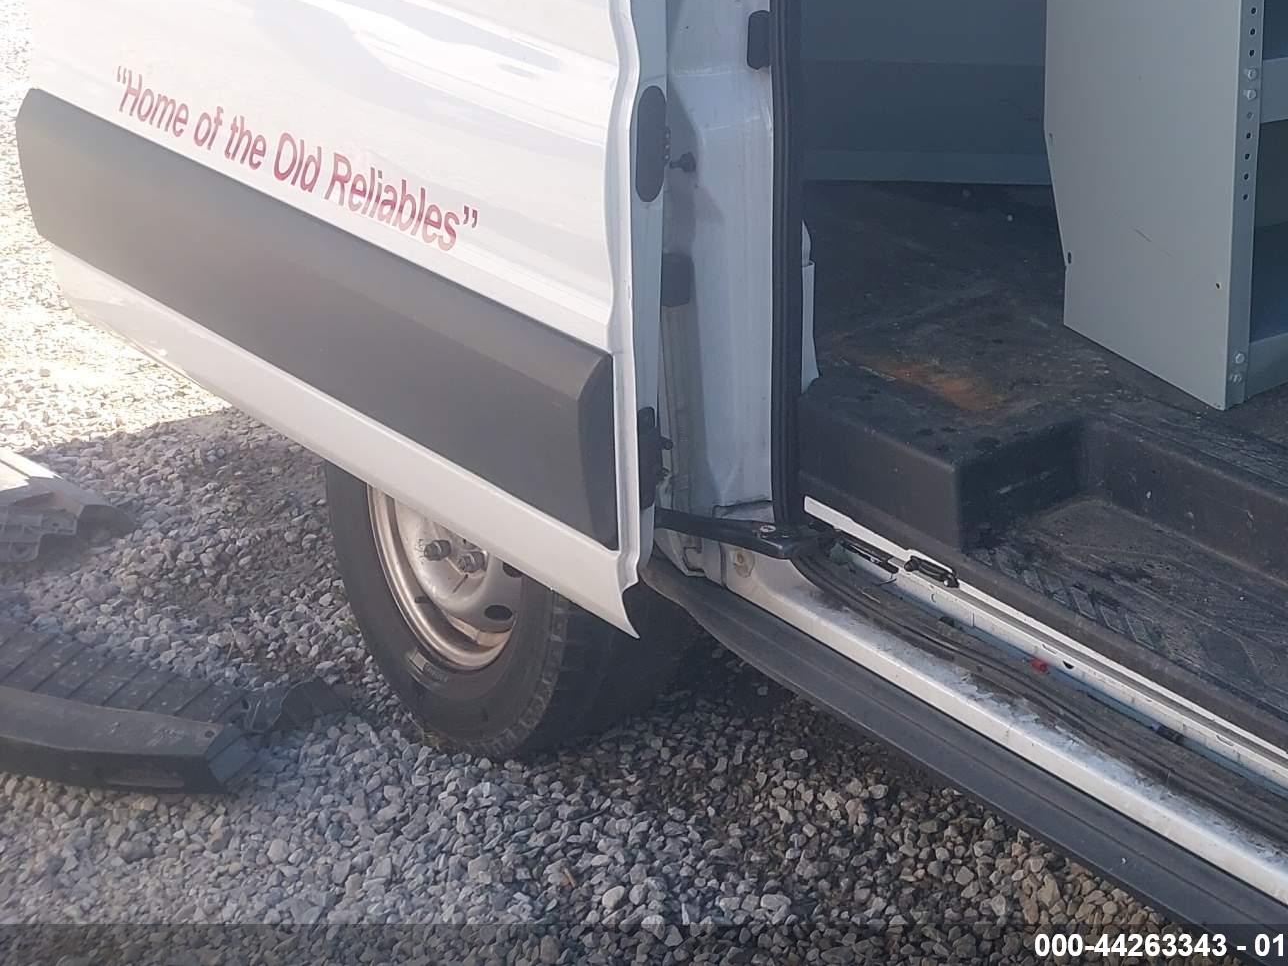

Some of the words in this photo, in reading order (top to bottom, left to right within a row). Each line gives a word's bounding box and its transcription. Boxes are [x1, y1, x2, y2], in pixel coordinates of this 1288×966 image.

[194, 106, 224, 151] of
[225, 115, 267, 171] the
[273, 132, 322, 194] Old
